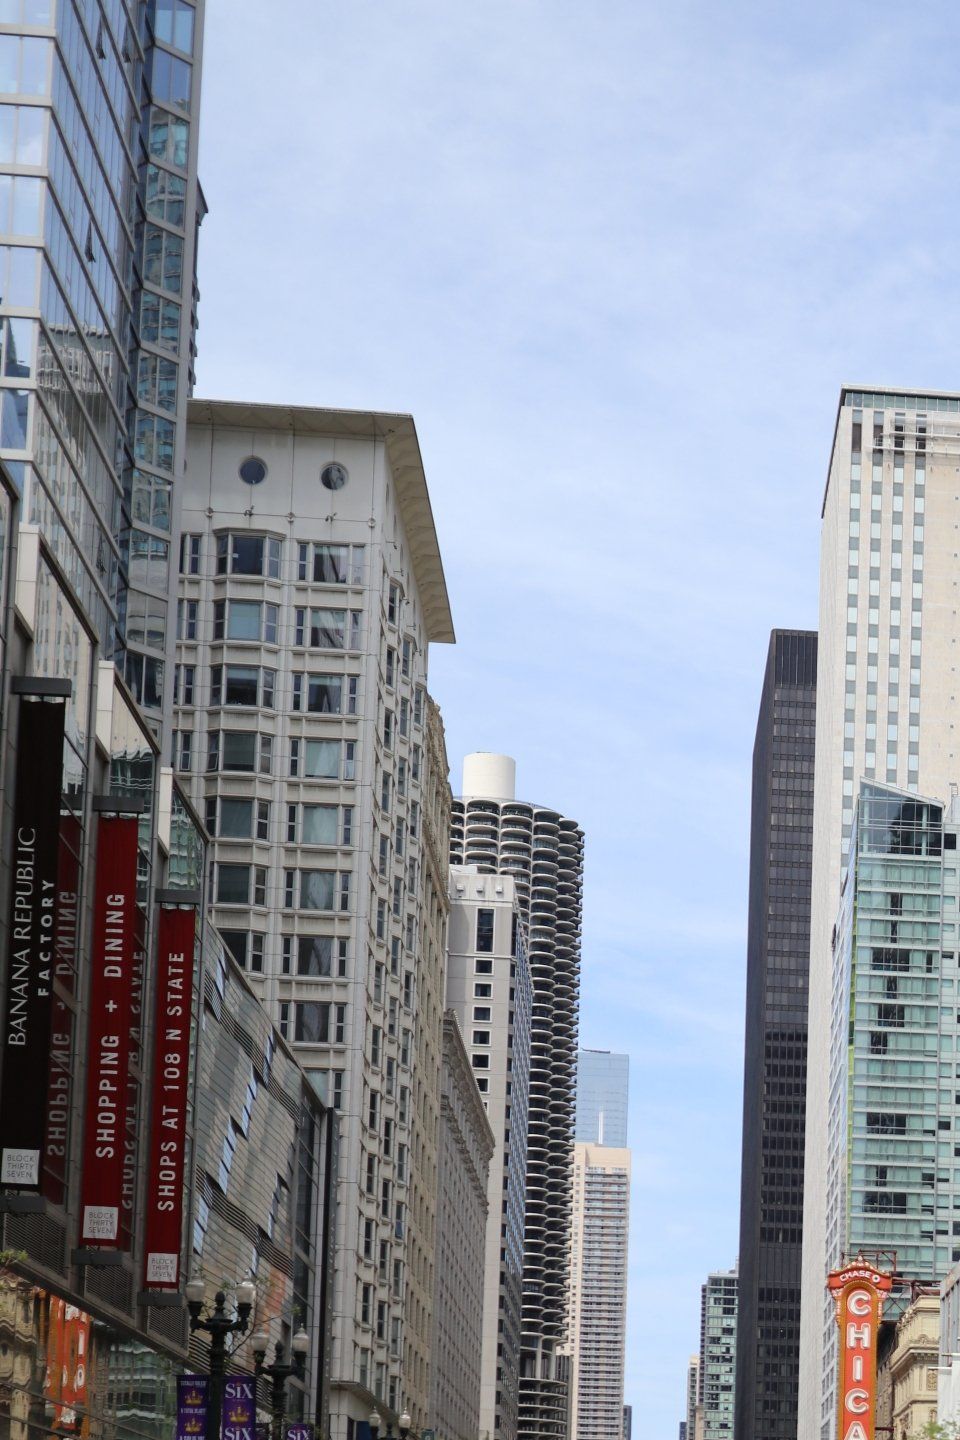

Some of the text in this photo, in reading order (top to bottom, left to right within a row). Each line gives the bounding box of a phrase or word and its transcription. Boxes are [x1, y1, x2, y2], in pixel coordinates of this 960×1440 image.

[8, 827, 36, 1046] BANANA REPUBLIC
[38, 880, 55, 996] FACTORY
[104, 894, 125, 978] DINING
[157, 952, 185, 1212] SHOPS AT 108 N STATE
[95, 1035, 120, 1159] SHOPPING
[7, 1154, 35, 1163] BLOCK
[7, 1162, 34, 1171] THIRTY
[7, 1170, 33, 1179] SEVEN
[88, 1211, 115, 1219] BLOCK
[88, 1219, 115, 1227] THIRTY
[88, 1226, 113, 1234] SEVEN
[151, 1257, 175, 1265] BLOCK
[151, 1264, 175, 1272] THIRTY
[840, 1270, 871, 1282] CHASE
